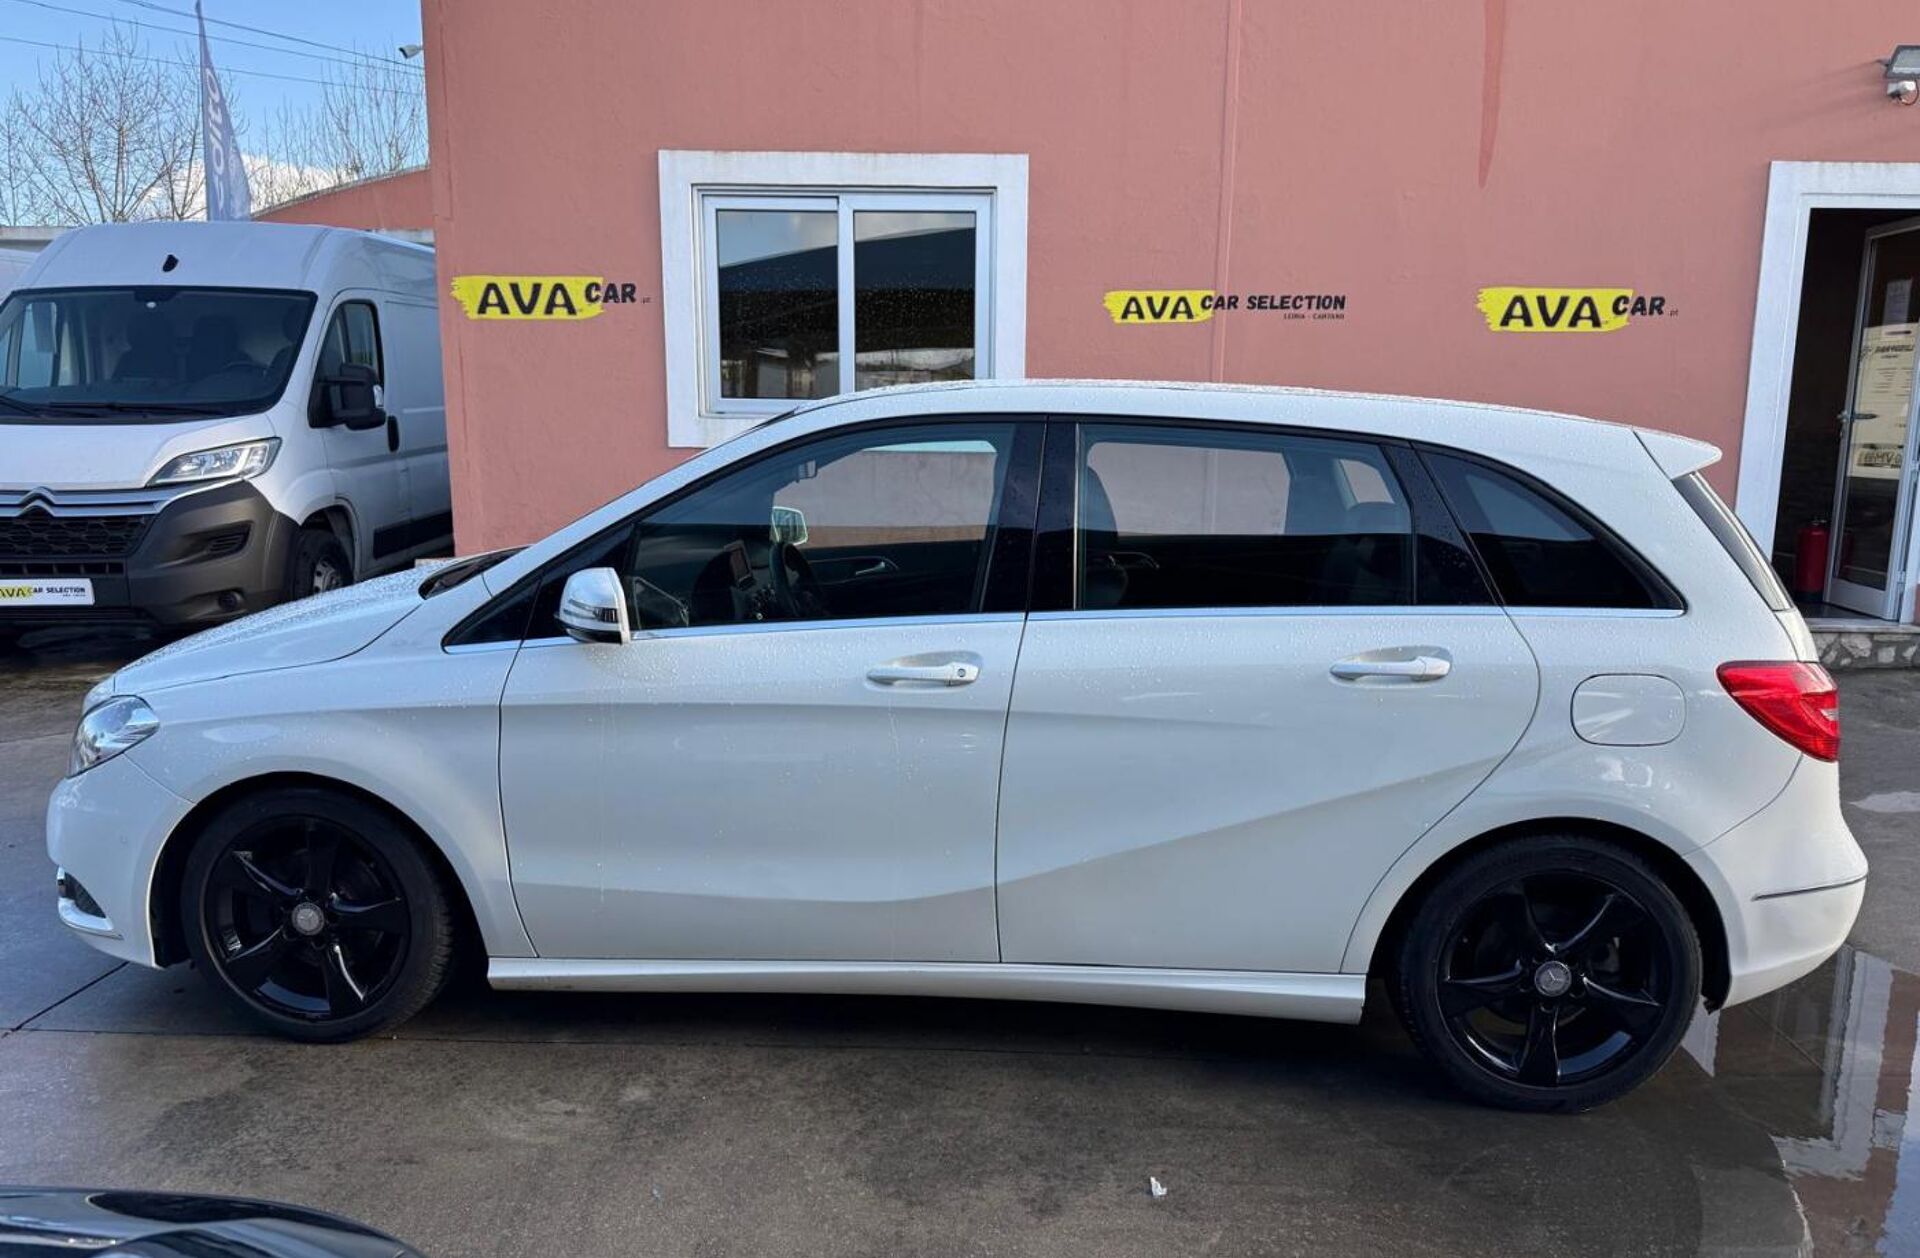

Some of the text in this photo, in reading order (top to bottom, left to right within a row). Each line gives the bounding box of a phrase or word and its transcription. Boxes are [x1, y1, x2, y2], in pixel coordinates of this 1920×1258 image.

[477, 282, 577, 315] AVA
[585, 281, 637, 304] CAR
[1121, 294, 1346, 320] AVA CAR SELECTION
[1500, 294, 1602, 328] AVA
[1612, 295, 1665, 316] CAR
